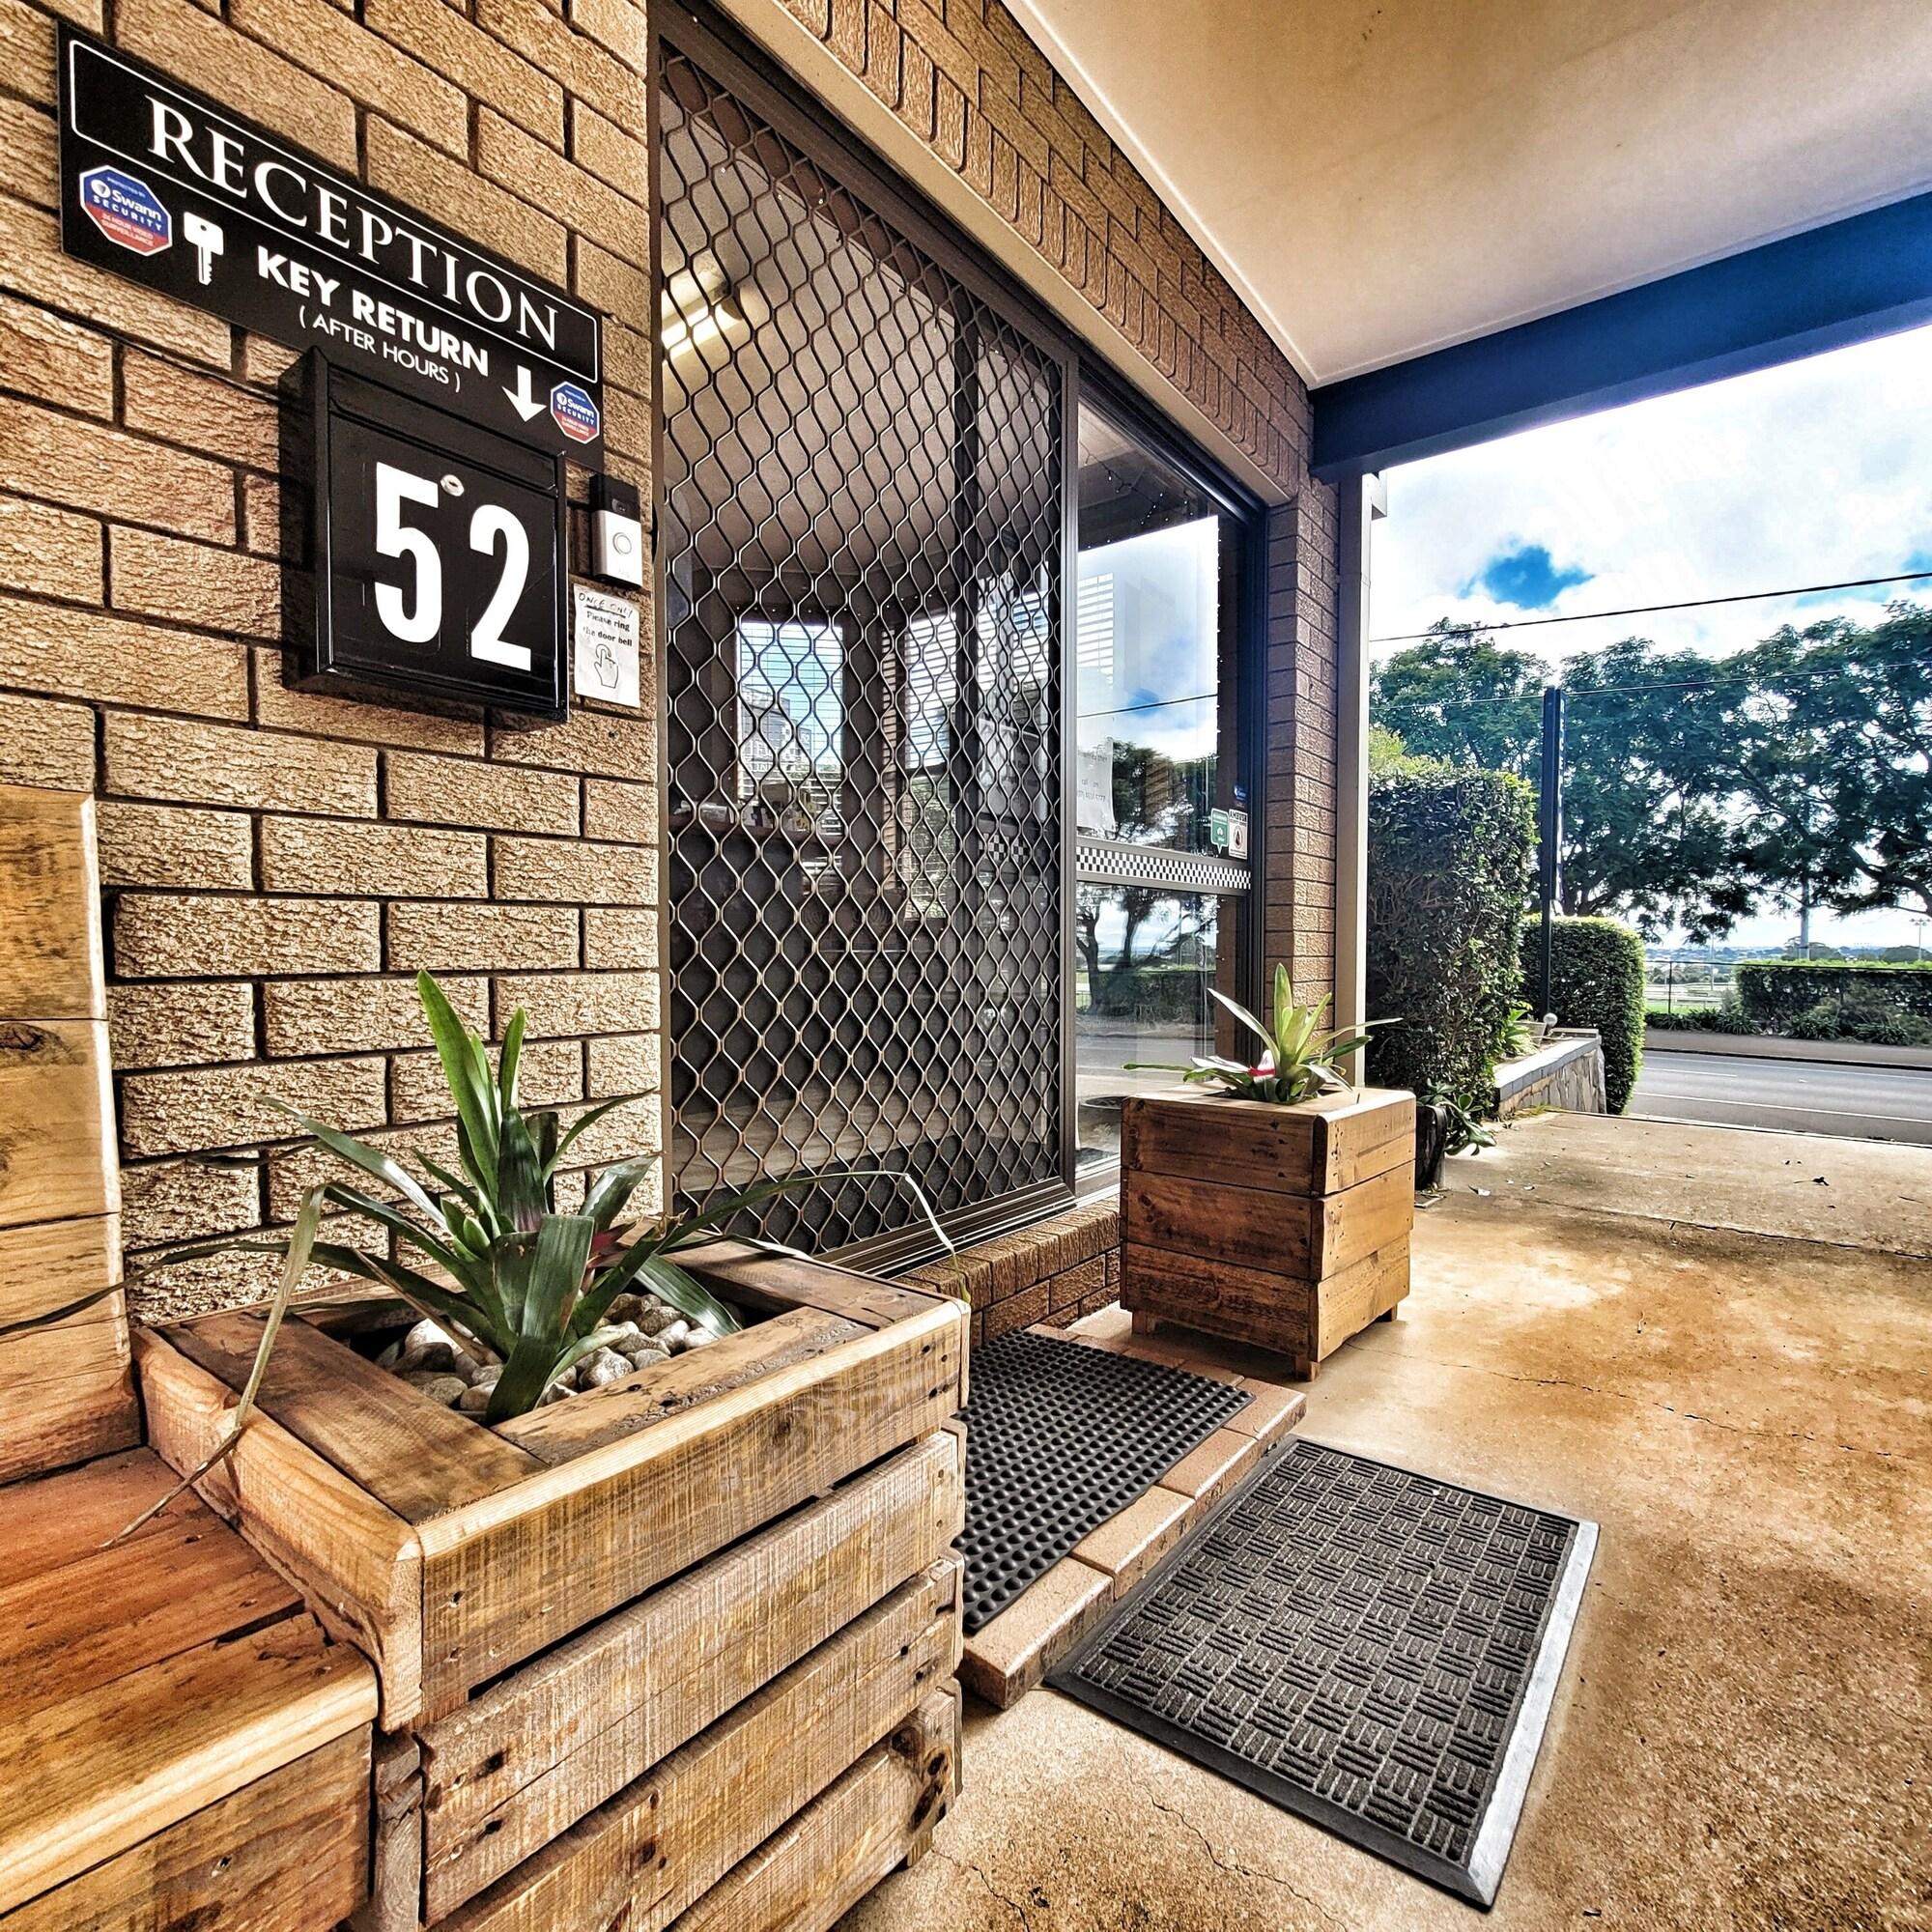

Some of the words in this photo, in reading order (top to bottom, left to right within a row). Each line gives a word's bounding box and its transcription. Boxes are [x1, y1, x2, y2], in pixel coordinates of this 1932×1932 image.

[93, 194, 162, 232] SECURITY
[111, 189, 162, 222] Swann
[145, 94, 558, 352] RECEPTION
[257, 244, 341, 307] KEY
[352, 290, 489, 378] RETURN
[557, 404, 595, 425] SECURITY
[567, 398, 595, 418] Swann
[375, 461, 531, 671] 52
[586, 611, 611, 626] Please
[614, 620, 631, 633] ring
[598, 631, 616, 642] door
[618, 637, 633, 647] bell
